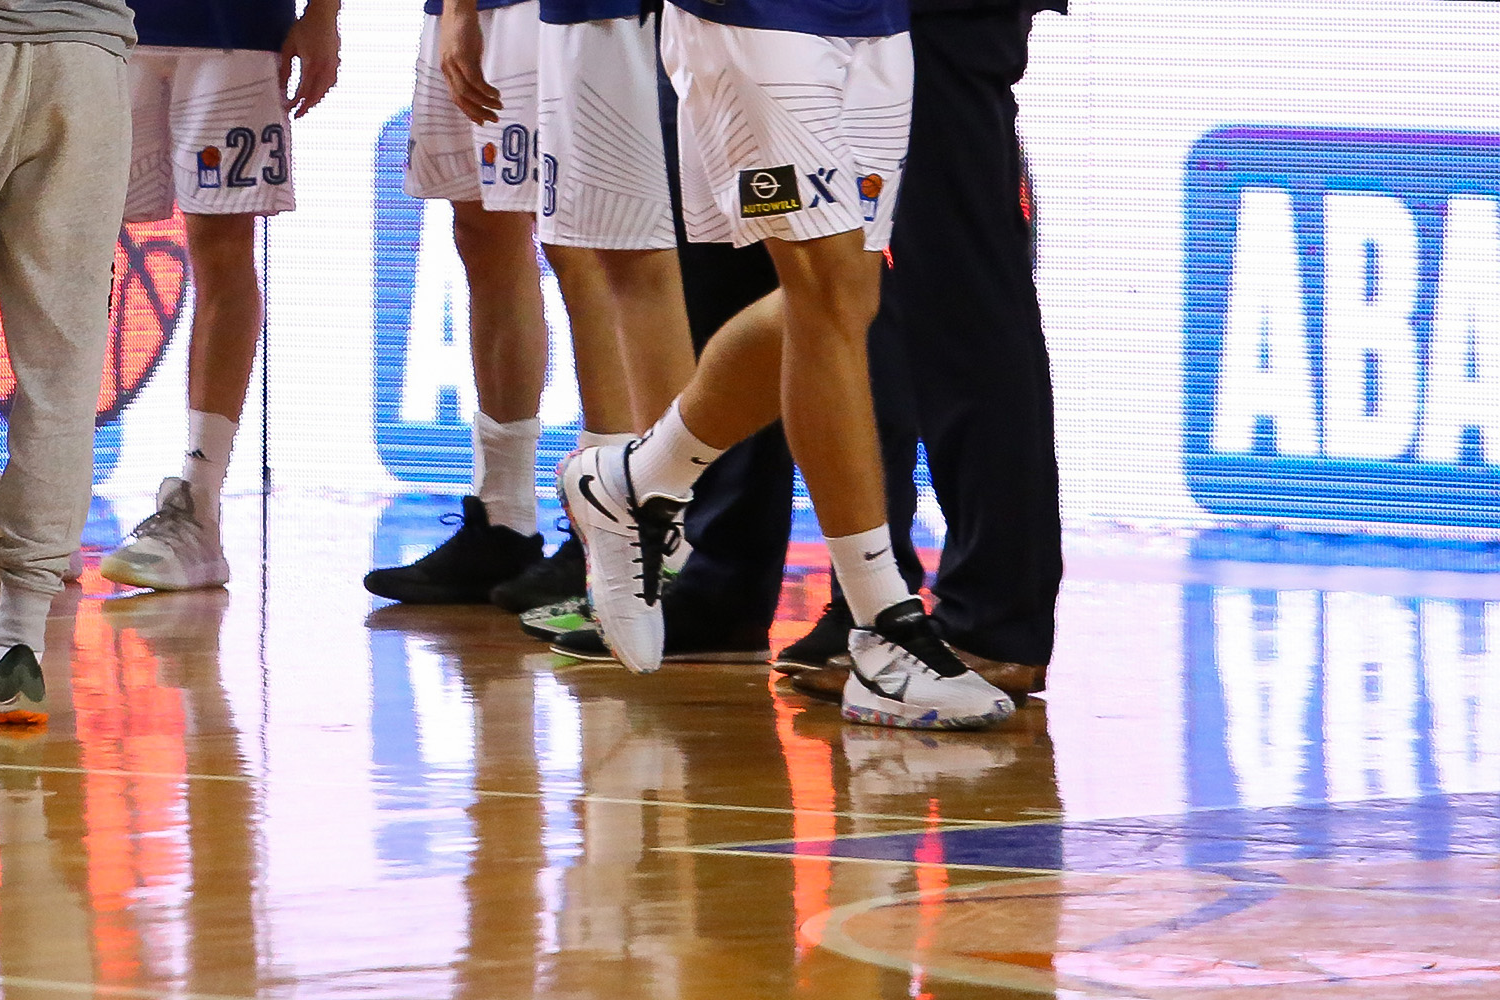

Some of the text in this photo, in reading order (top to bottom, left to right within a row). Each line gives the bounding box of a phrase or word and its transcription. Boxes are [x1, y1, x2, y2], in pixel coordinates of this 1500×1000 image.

[226, 123, 288, 188] 23
[742, 198, 800, 214] AUTOWILL
[1211, 186, 1500, 466] ABA
